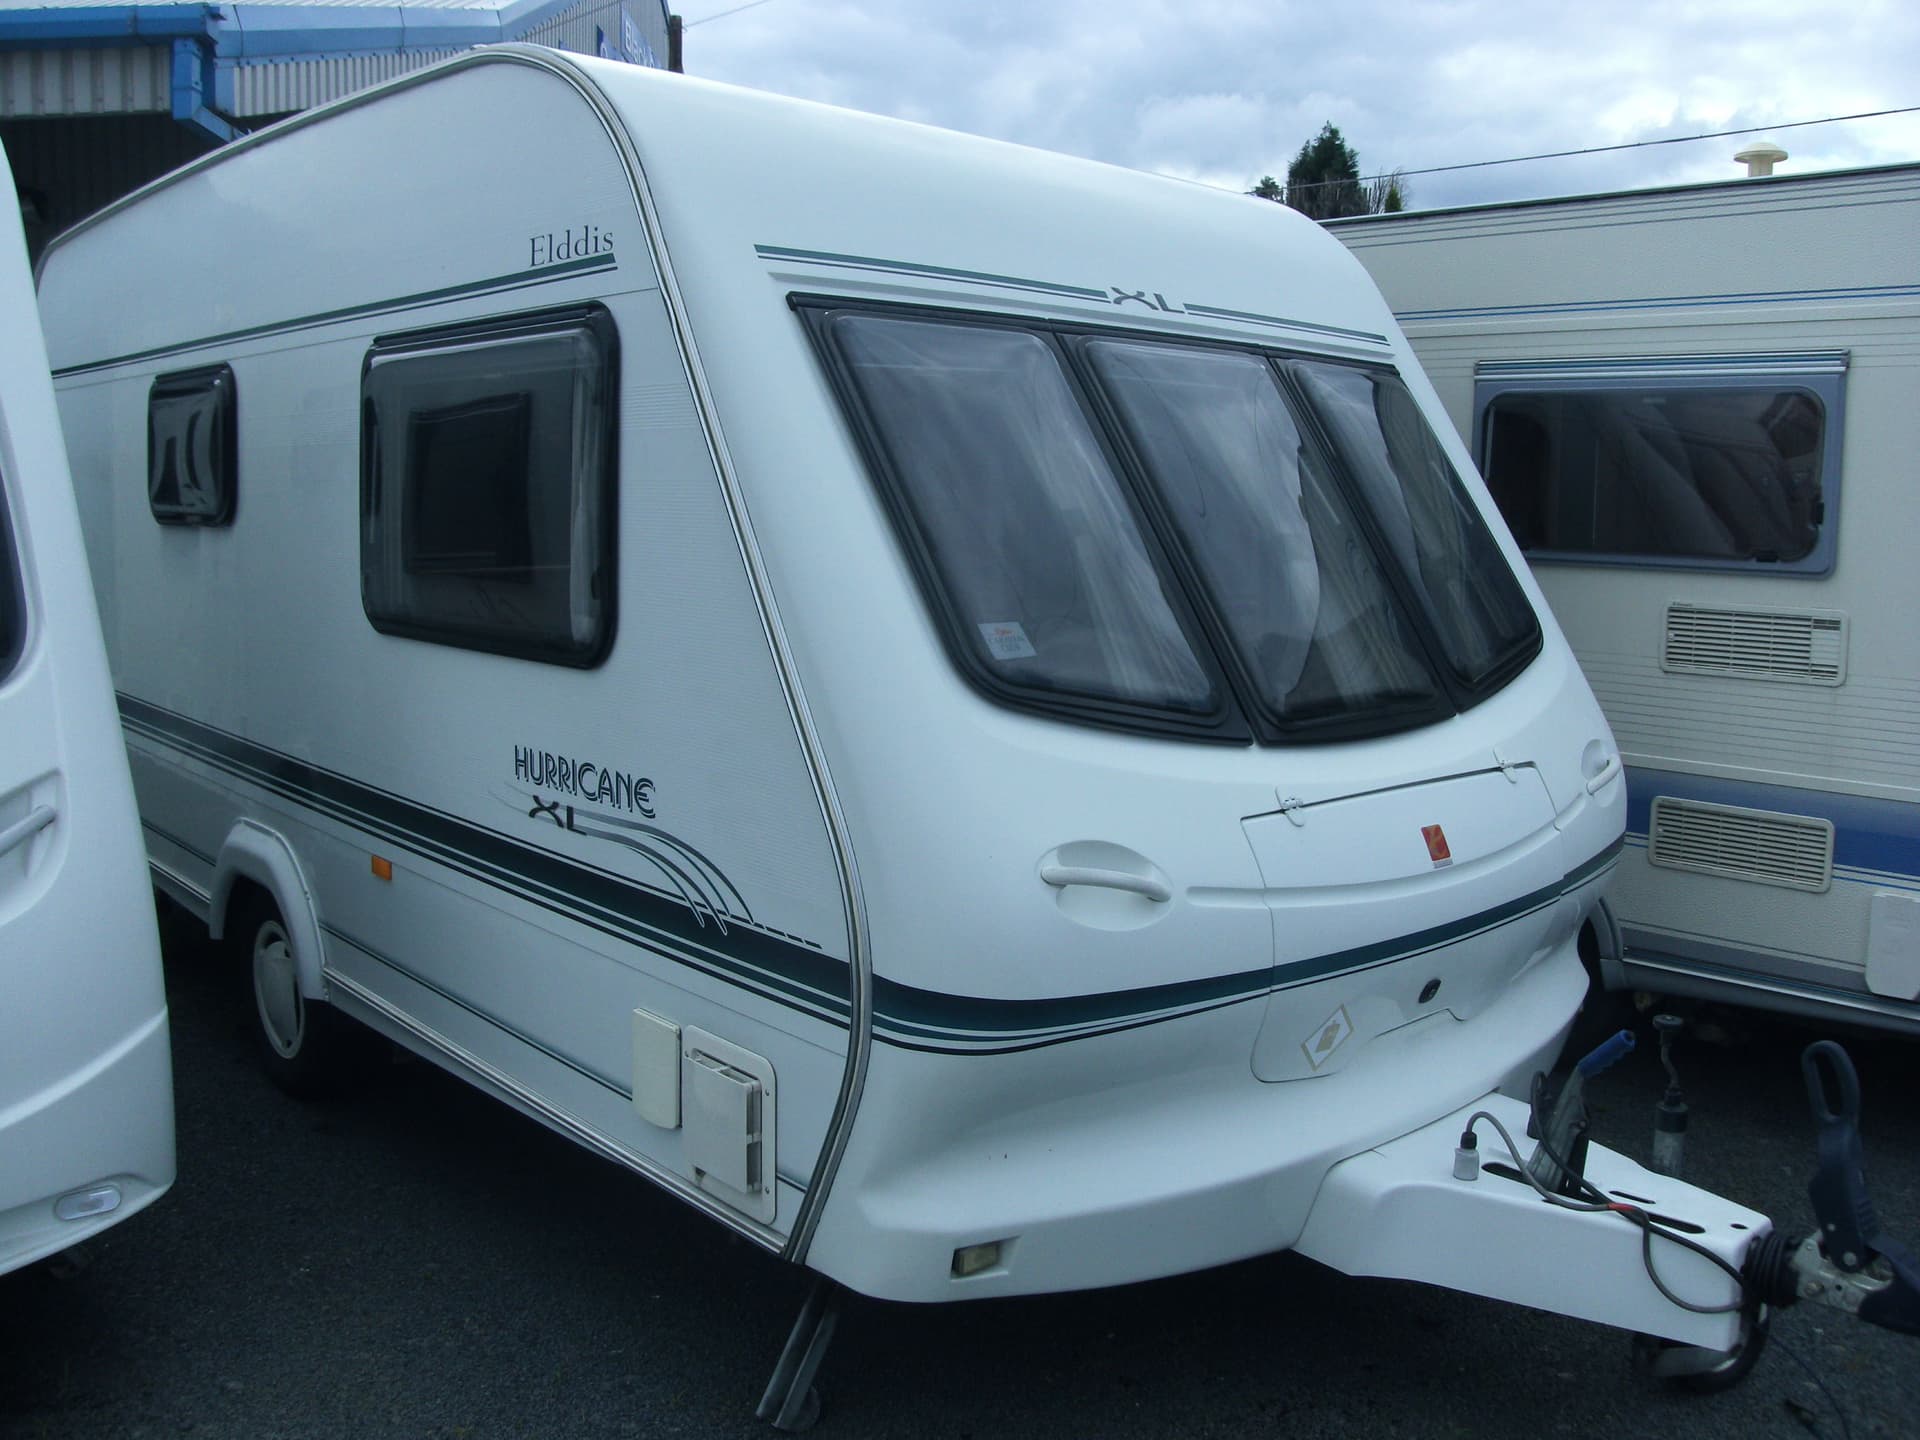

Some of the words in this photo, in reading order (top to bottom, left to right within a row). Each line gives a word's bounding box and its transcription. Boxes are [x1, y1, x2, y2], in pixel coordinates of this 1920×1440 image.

[529, 224, 615, 267] Elddis
[1109, 286, 1186, 314] XL
[513, 744, 657, 819] HURRICANE
[528, 794, 589, 836] XL
